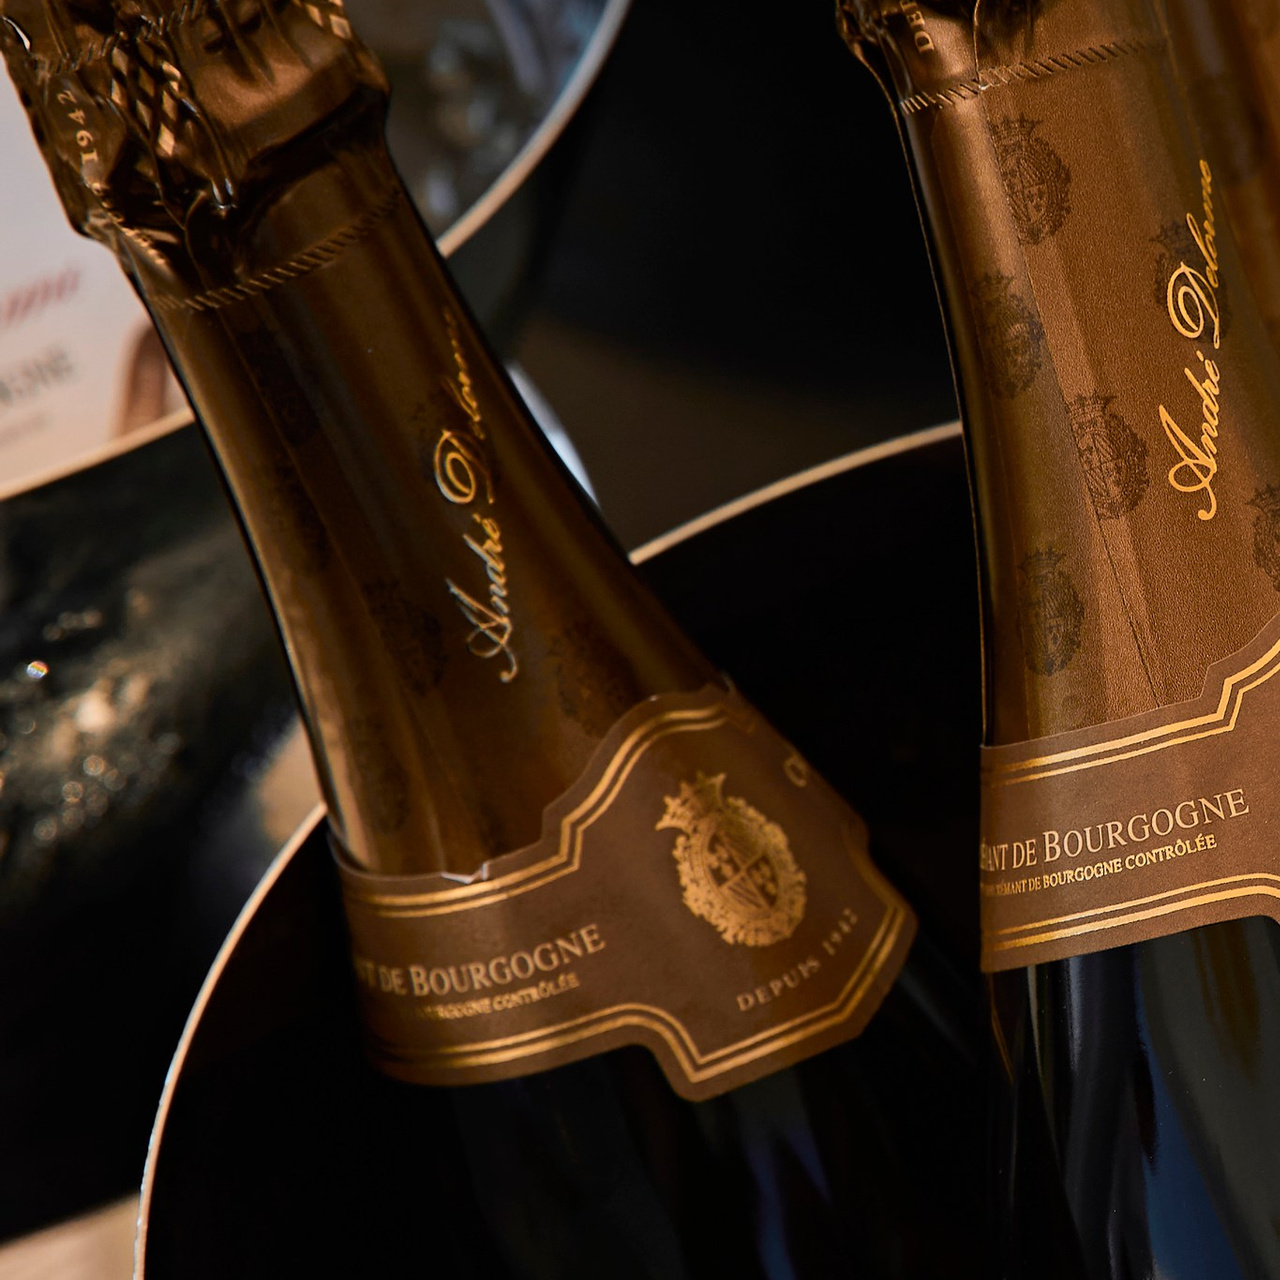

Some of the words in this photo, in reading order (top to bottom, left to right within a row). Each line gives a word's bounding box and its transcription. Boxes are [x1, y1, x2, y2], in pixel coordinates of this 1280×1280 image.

[57, 89, 99, 165] 1942
[1158, 350, 1220, 521] André
[445, 513, 518, 683] André
[1012, 838, 1038, 869] DE
[1043, 788, 1250, 863] BOURGOGNE
[1028, 876, 1042, 892] DE
[1042, 858, 1123, 889] BOURGOGNE
[1125, 833, 1218, 870] CONTRÔLÉE
[409, 922, 606, 997] BOURGOGNE
